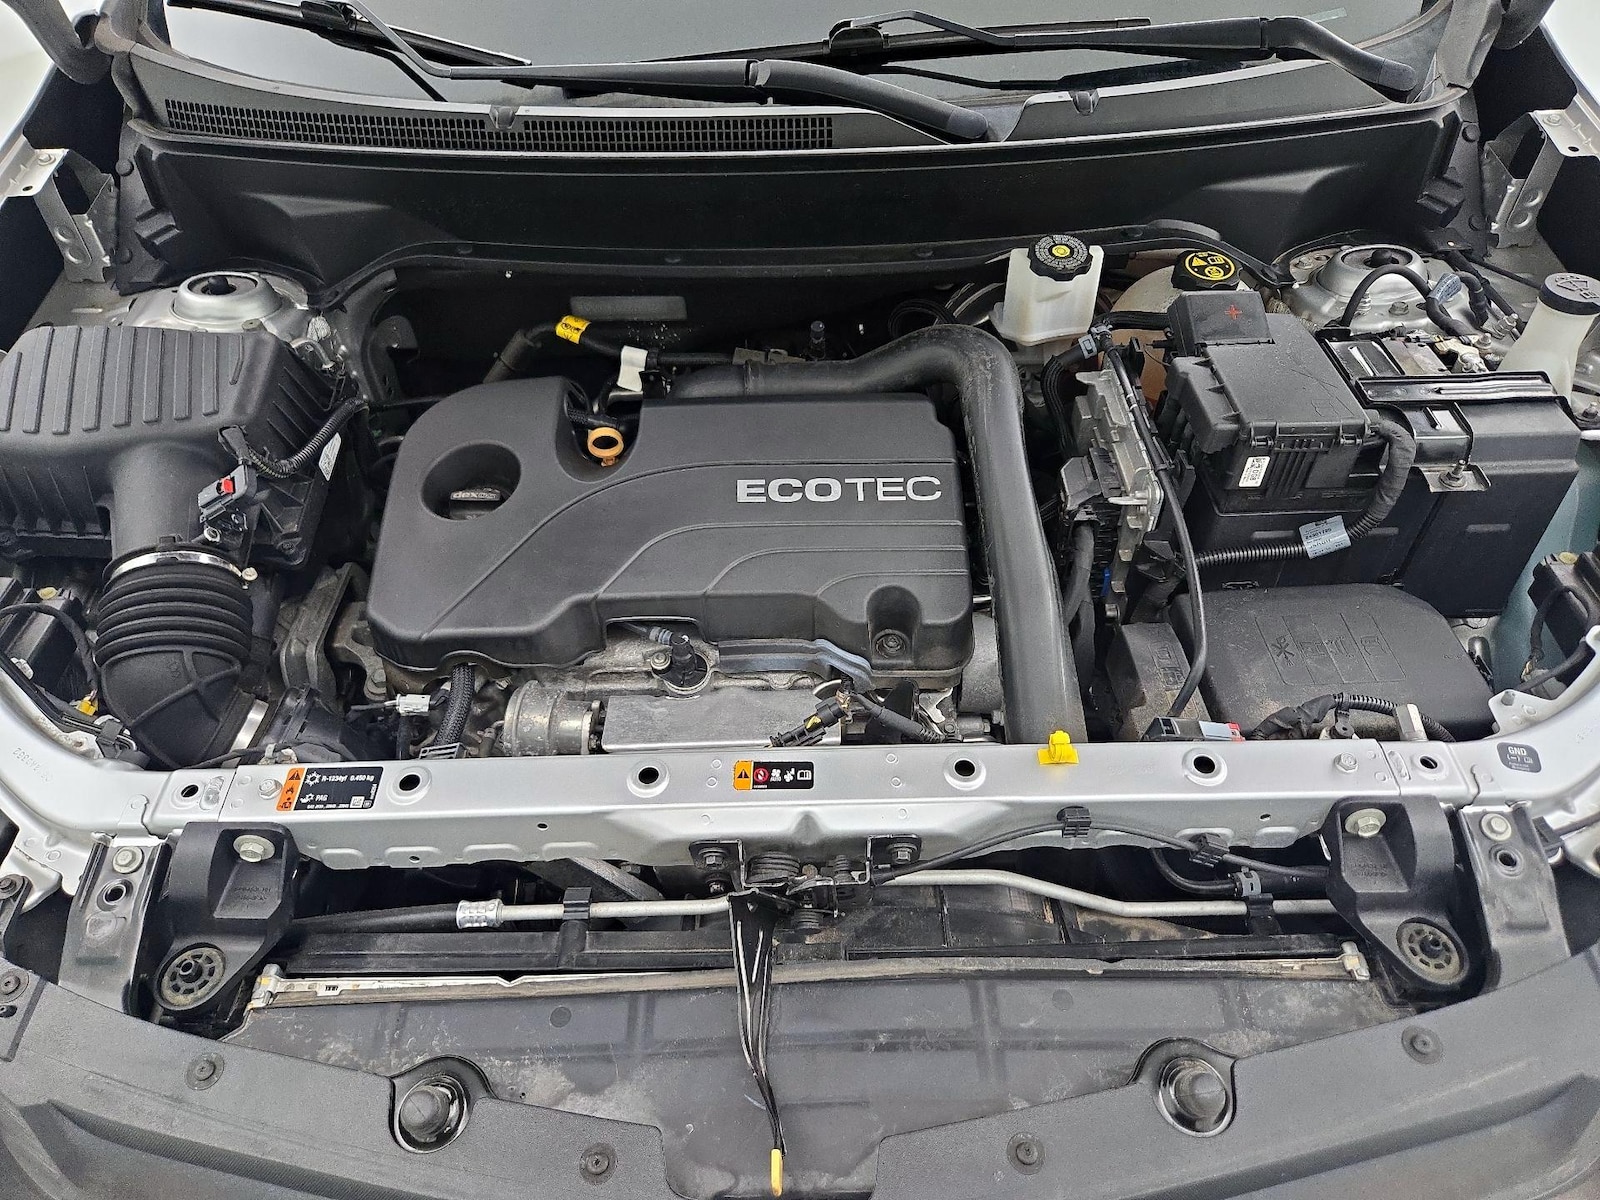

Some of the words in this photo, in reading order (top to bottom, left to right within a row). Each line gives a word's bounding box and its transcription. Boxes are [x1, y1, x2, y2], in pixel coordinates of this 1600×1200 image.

[736, 475, 942, 503] ECOTEC
[1508, 746, 1527, 755] GND
[321, 775, 348, 783] R-1234yf
[366, 774, 375, 782] kg
[315, 794, 328, 802] PAG
